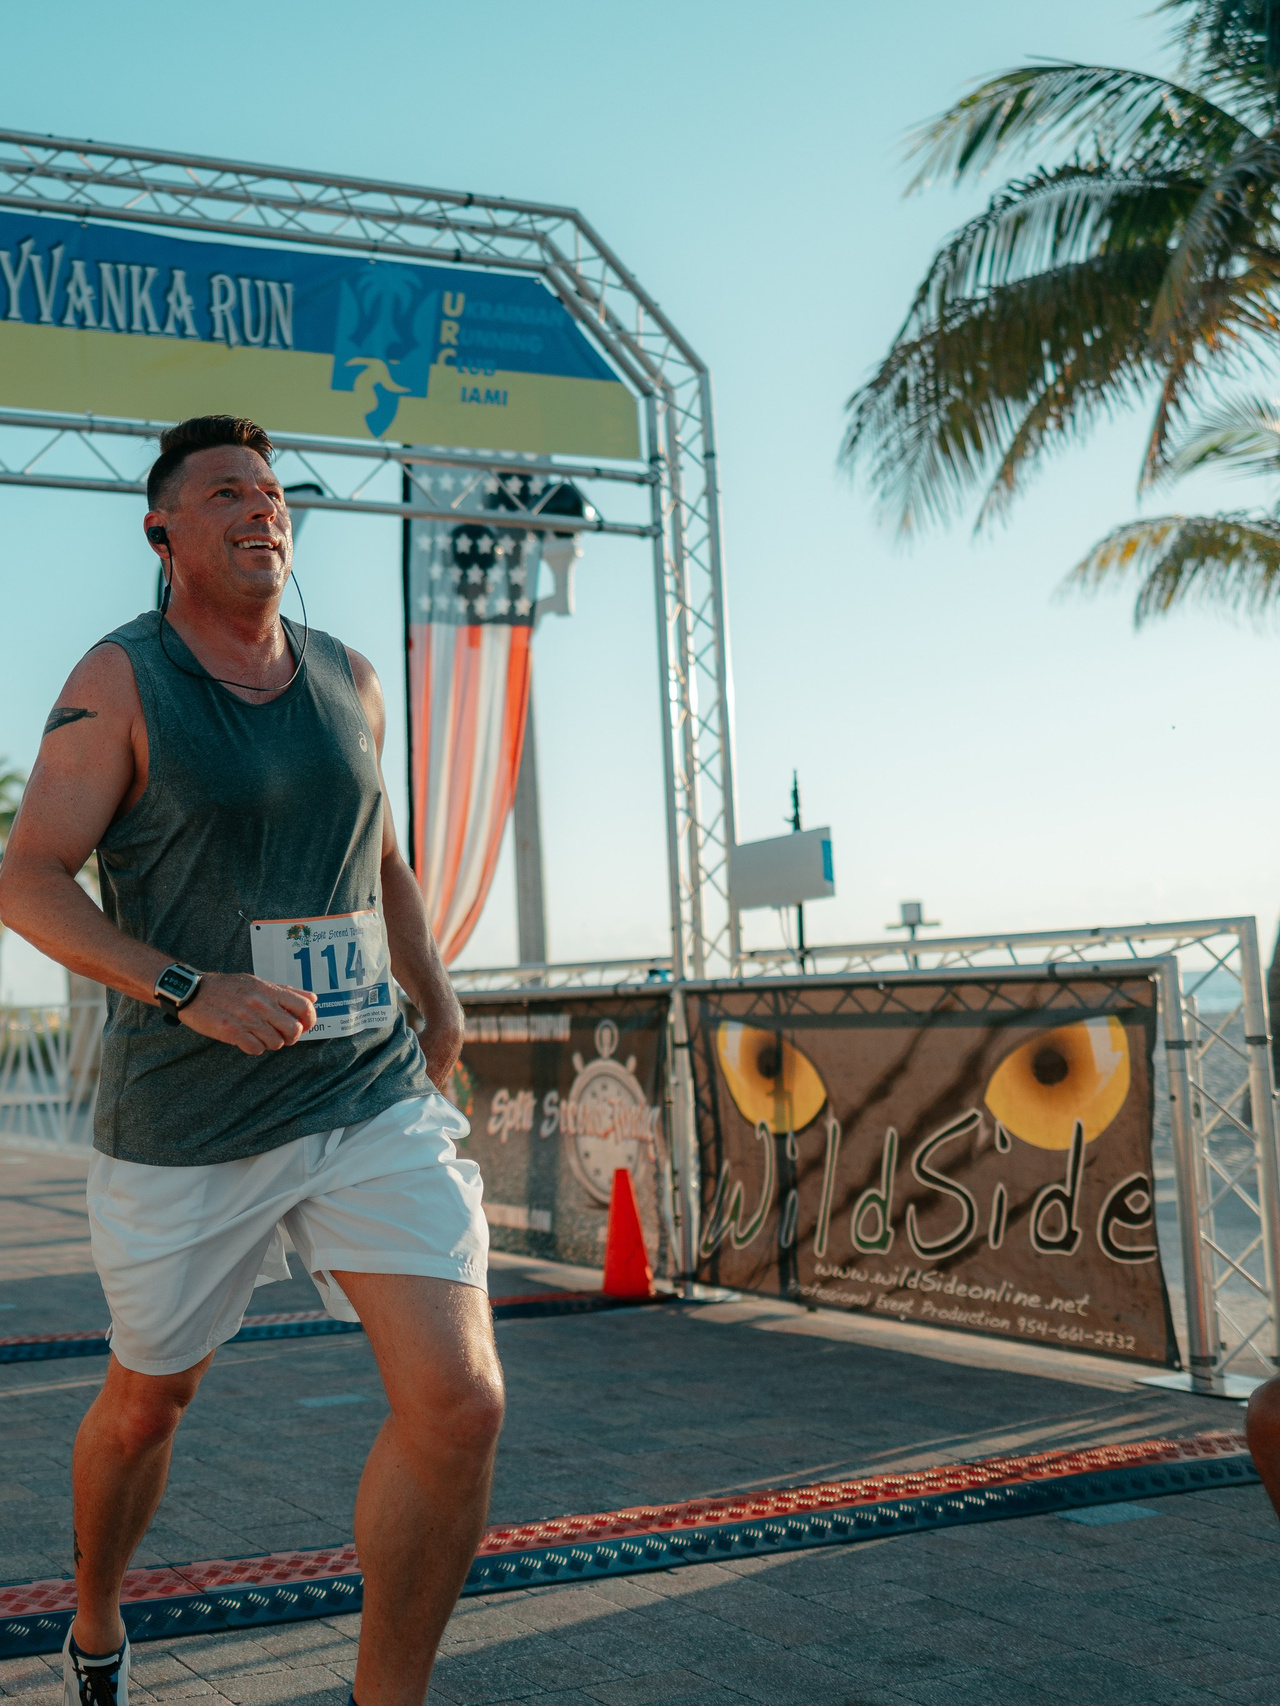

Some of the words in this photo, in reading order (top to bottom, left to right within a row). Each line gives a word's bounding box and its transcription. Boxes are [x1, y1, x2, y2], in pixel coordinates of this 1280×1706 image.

[209, 273, 295, 349] RUN
[293, 941, 366, 992] 114
[875, 1291, 915, 1314] Event
[922, 1300, 1011, 1330] Production
